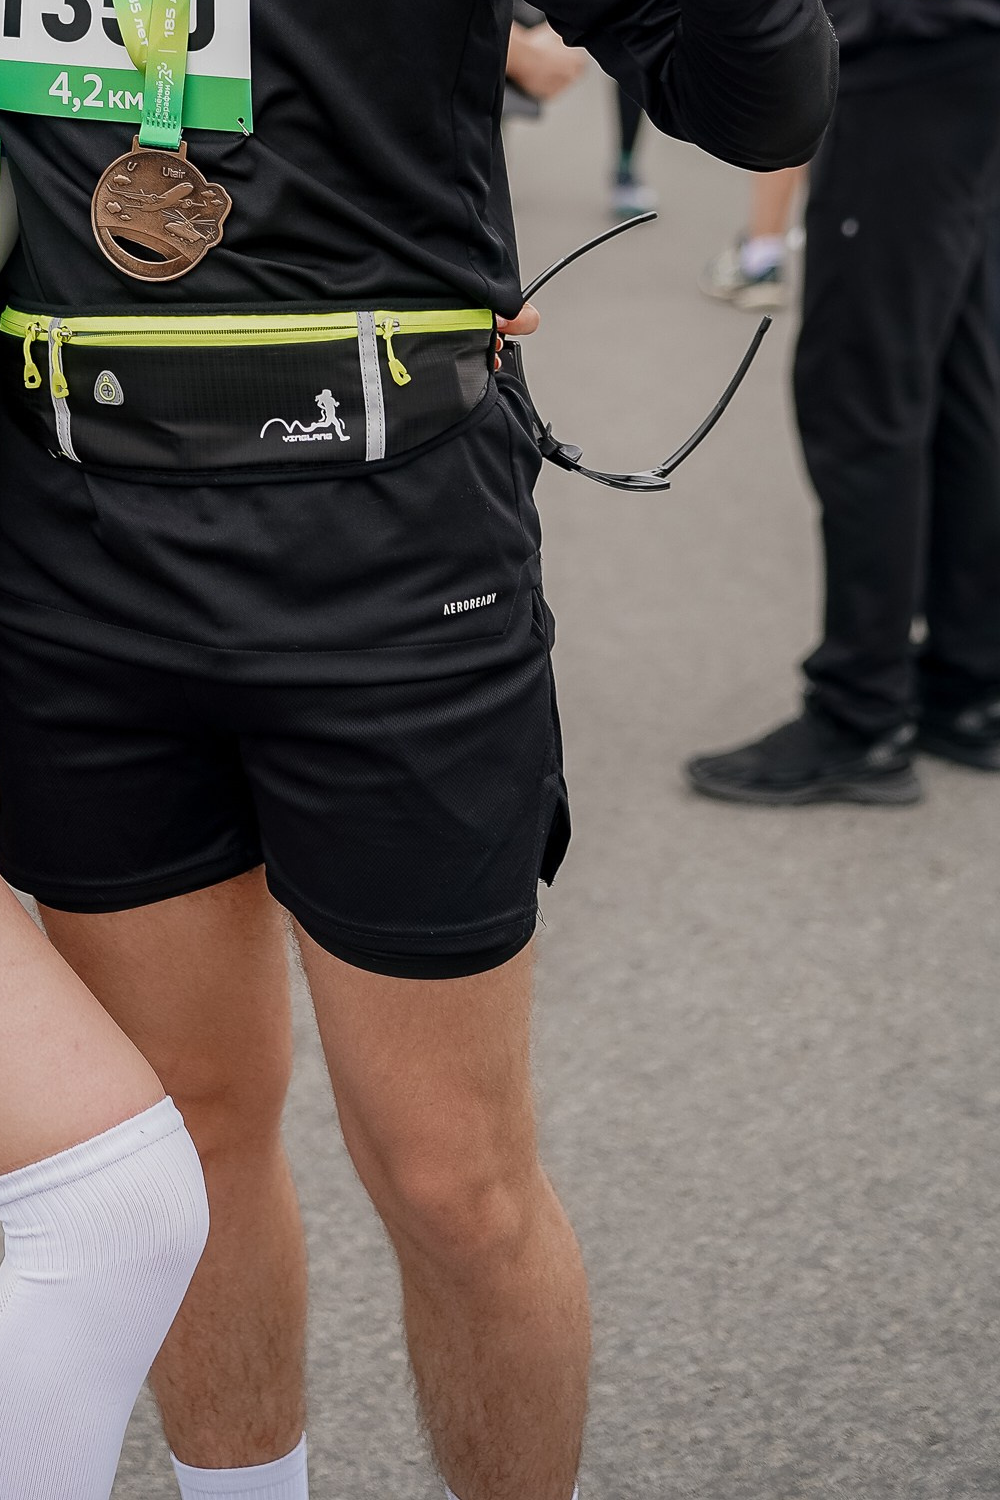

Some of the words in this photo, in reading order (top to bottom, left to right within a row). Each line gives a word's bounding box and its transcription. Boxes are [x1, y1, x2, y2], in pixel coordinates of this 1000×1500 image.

[134, 18, 149, 46] лет
[164, 8, 176, 37] 185
[162, 167, 186, 179] Utair
[443, 592, 497, 616] AEROREADY
